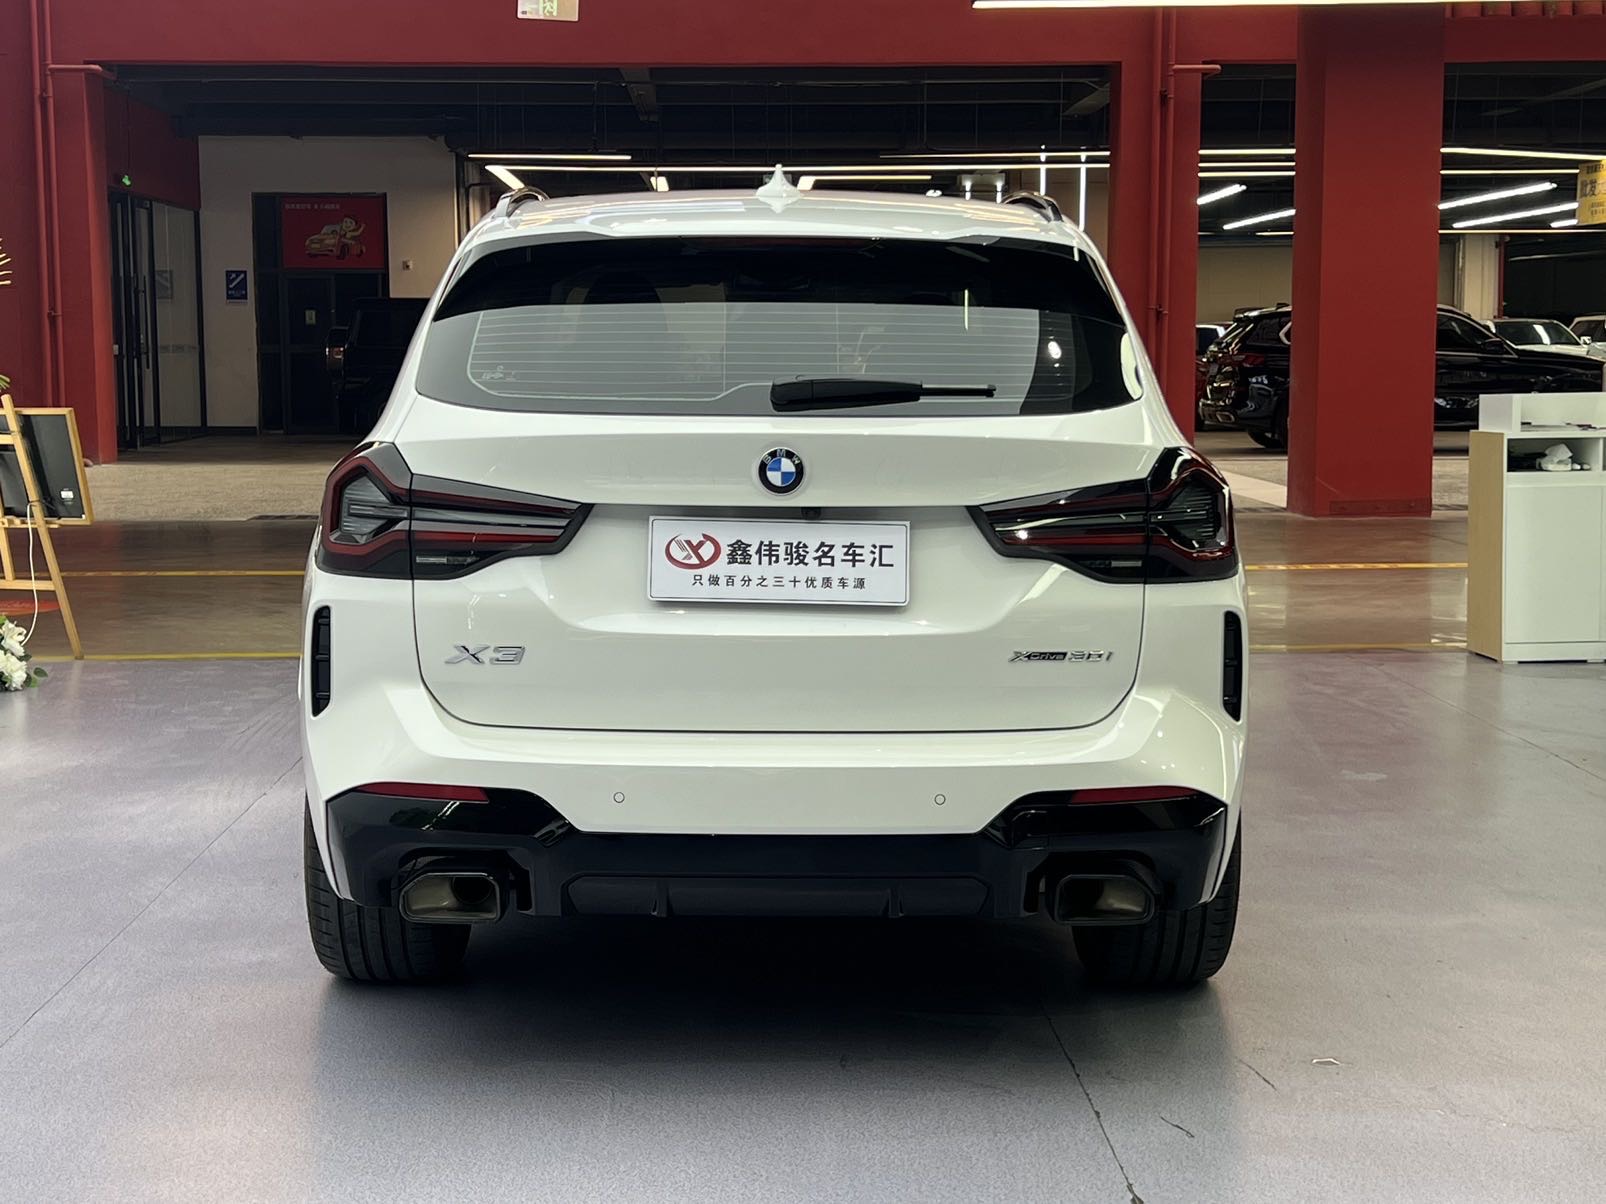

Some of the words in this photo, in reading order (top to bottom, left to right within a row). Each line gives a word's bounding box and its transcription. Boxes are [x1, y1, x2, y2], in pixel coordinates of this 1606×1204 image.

[762, 448, 801, 465] BMW
[726, 539, 895, 568] 鑫伟骏名车汇
[692, 574, 866, 590] 只做百分之三十优质车源
[444, 645, 526, 666] X3
